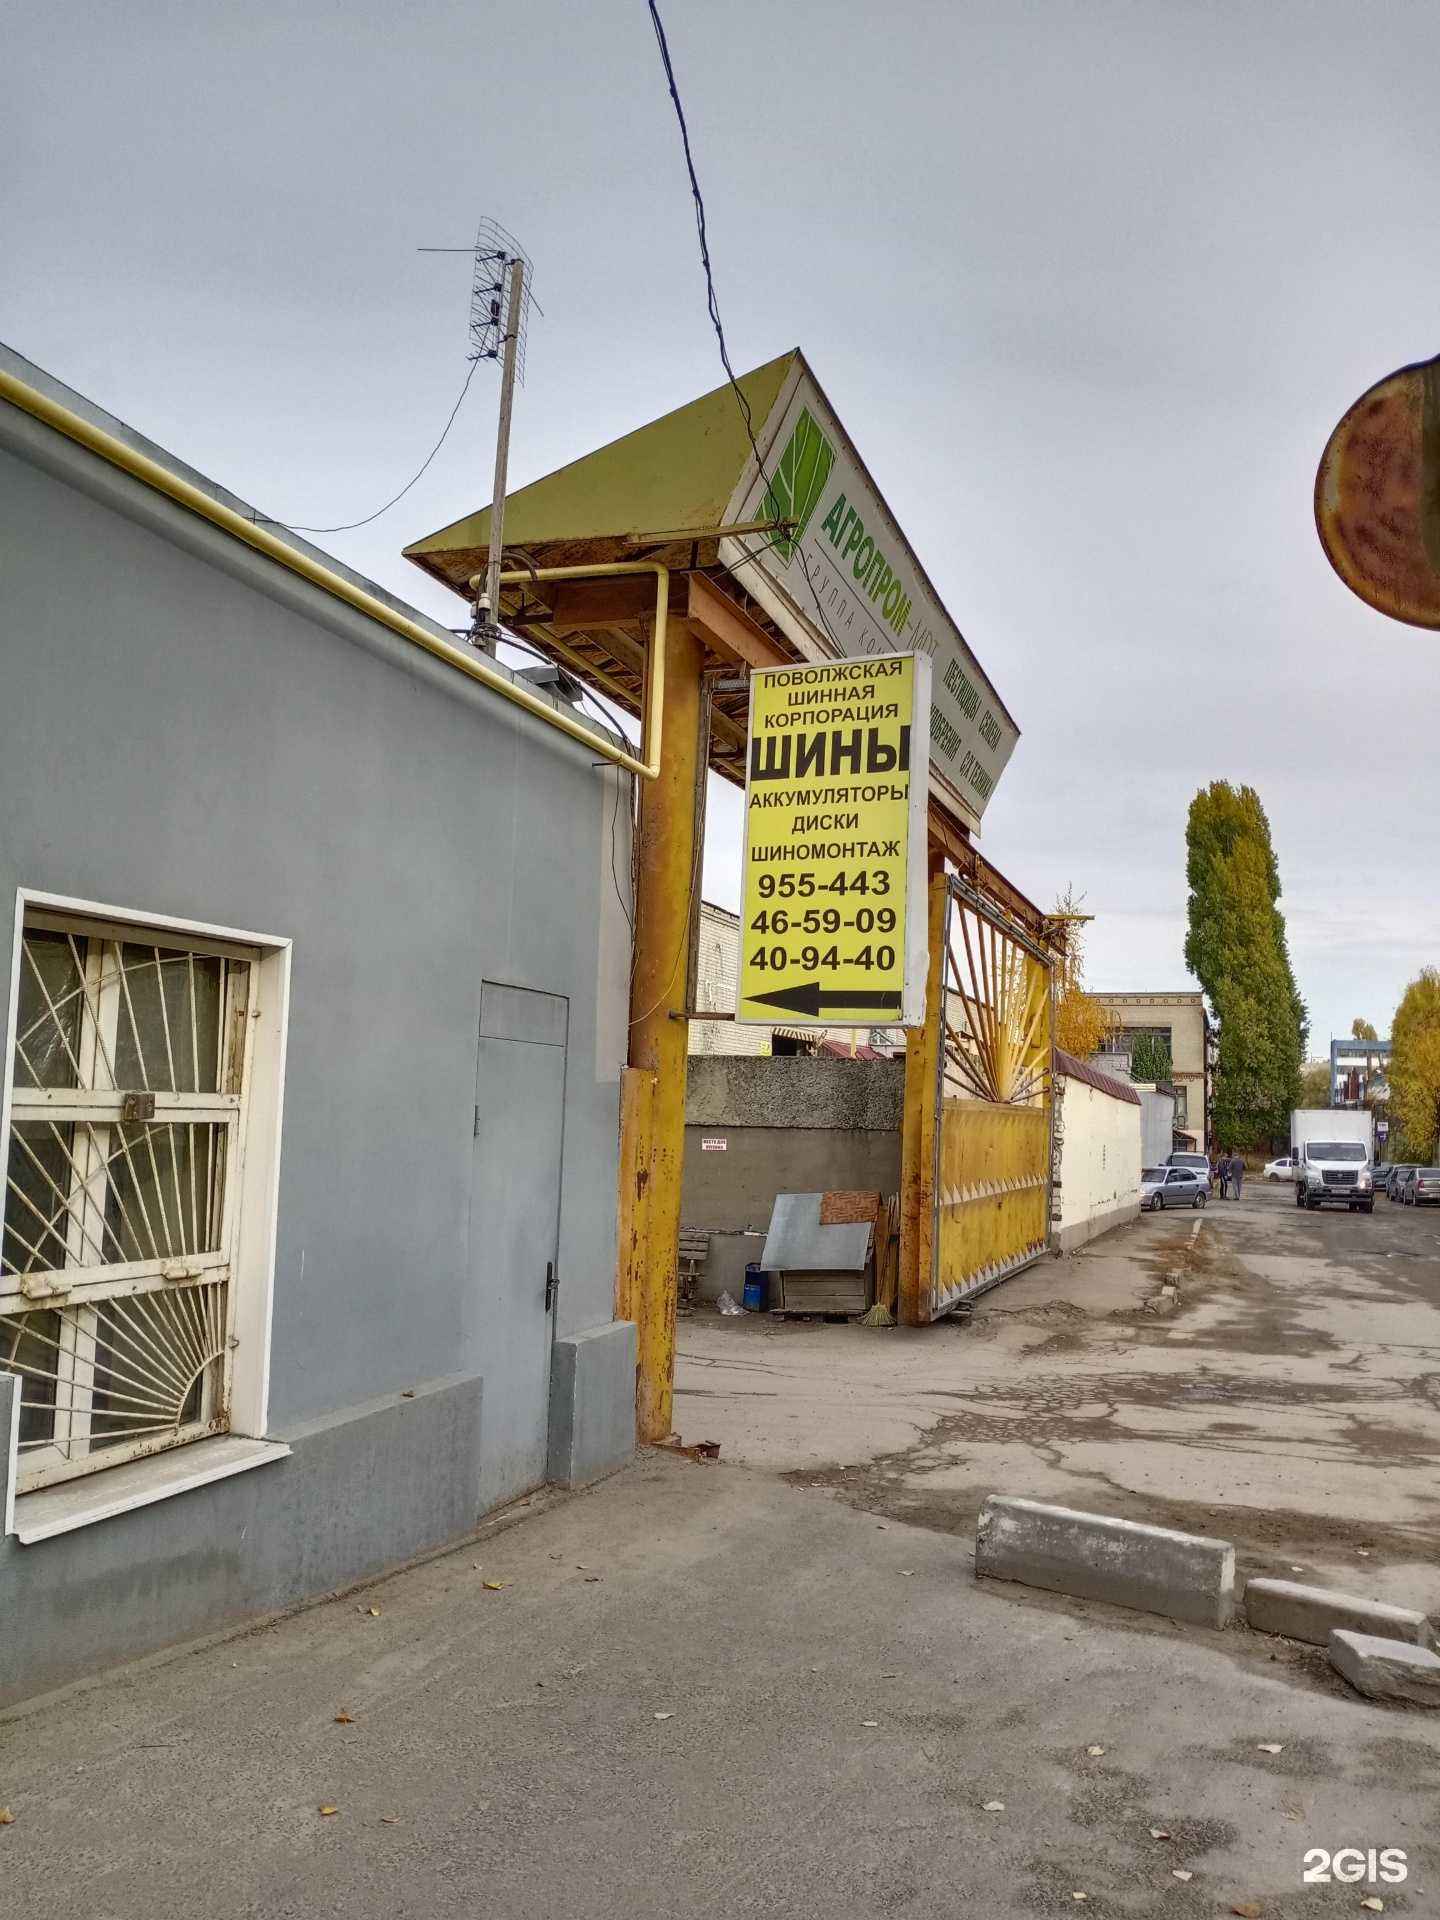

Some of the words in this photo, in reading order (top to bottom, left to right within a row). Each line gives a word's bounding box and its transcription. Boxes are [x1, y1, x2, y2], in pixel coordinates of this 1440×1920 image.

[804, 553, 855, 629] ГРУППА
[764, 661, 903, 688] ПОВОЛЖСКАЯ
[788, 684, 875, 707] ШИННАЯ
[764, 703, 899, 729] КОРПОРАЦИЯ
[978, 709, 1002, 752] СЕМЕНА
[751, 725, 912, 781] ШИНЫ
[749, 783, 909, 809] АККУМУЛЯТОРЫ
[791, 813, 859, 835] ДИСКИ
[751, 840, 901, 862] ШИНОМОНТАЖ
[758, 870, 891, 898] 955-443
[751, 907, 897, 935] 46-59-09
[749, 945, 896, 971] 40-94-40
